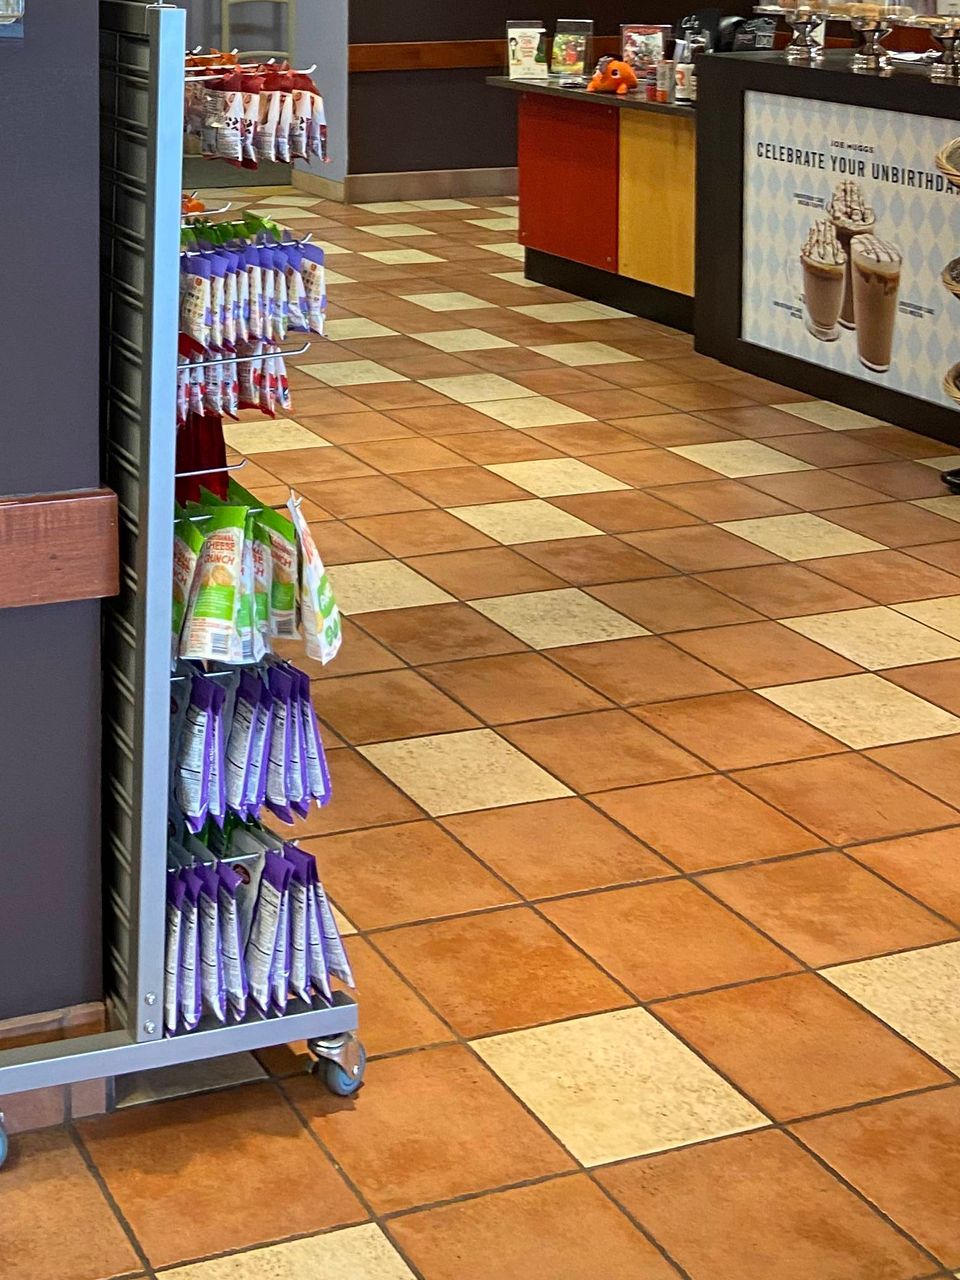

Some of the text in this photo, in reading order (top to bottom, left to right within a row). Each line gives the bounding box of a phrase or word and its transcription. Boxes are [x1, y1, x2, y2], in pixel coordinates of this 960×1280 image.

[830, 140, 875, 154] JOE MUGGS
[756, 142, 825, 169] CELEBRATE
[830, 155, 865, 177] YOUR
